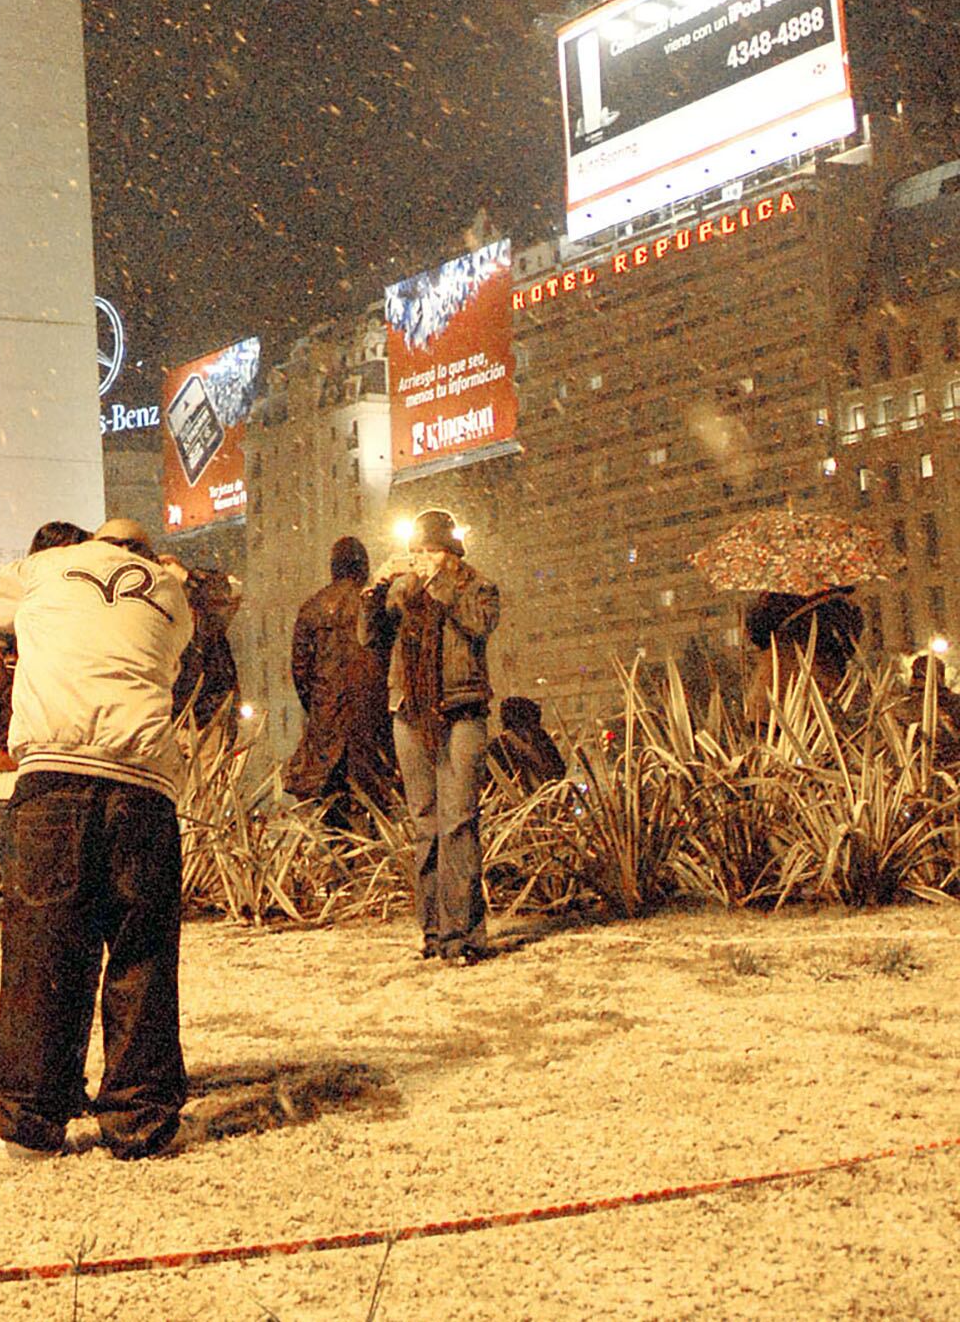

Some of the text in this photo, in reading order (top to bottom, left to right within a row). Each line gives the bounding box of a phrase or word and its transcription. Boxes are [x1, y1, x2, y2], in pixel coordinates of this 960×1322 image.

[693, 24, 712, 42] con
[714, 15, 728, 31] un
[727, 6, 824, 68] 4348-4888
[512, 266, 596, 311] HOTEL
[437, 363, 448, 379] lo
[448, 359, 467, 379] que
[405, 389, 435, 408] menos
[436, 384, 447, 398] tu
[426, 404, 495, 451] Kingston
